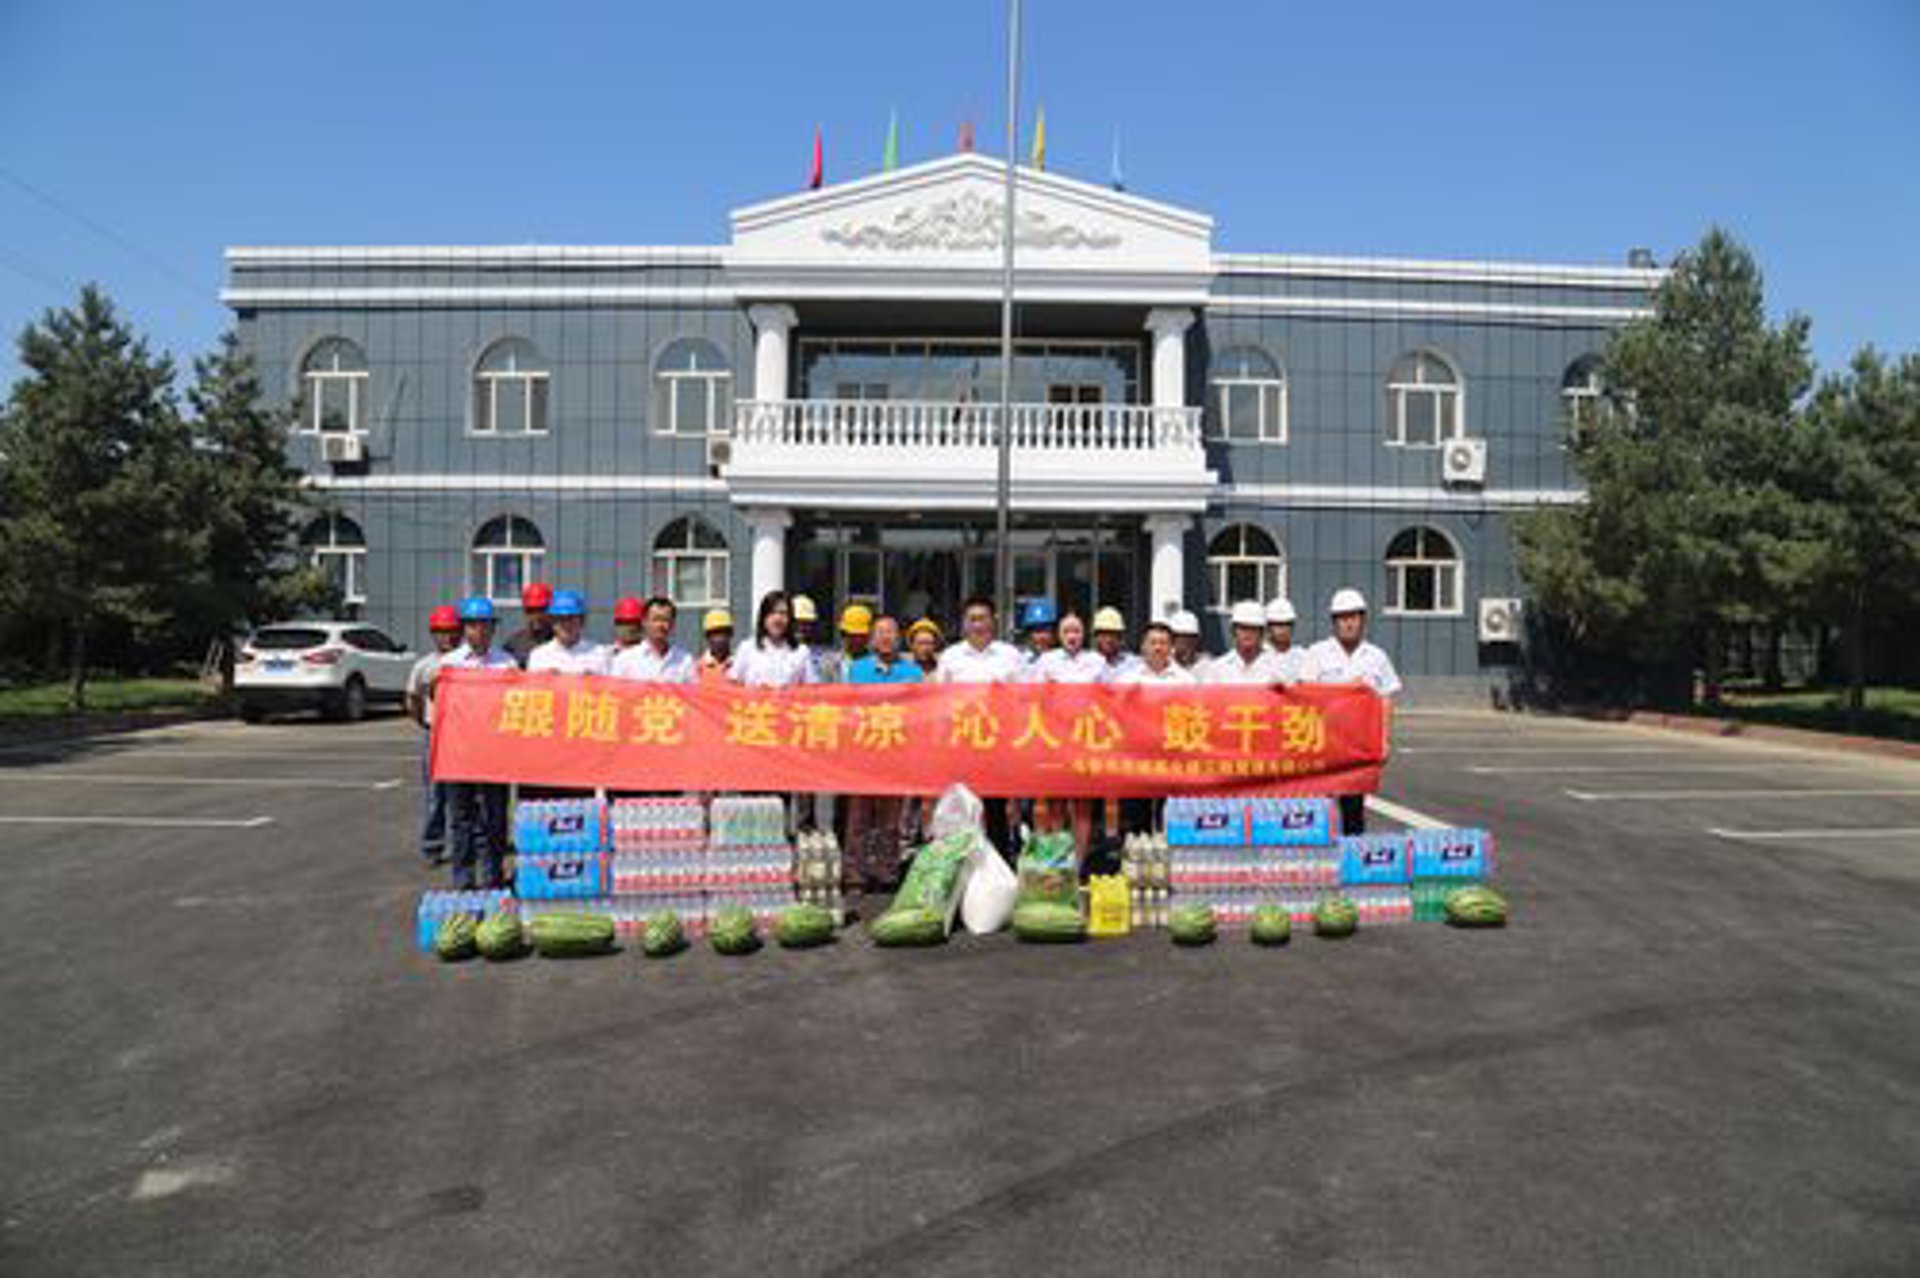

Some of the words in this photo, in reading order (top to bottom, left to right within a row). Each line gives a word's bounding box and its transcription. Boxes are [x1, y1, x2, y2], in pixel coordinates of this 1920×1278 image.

[499, 689, 685, 745] 跟随党
[951, 701, 1123, 749] 沁人心
[1162, 704, 1327, 753] 鼓干劲
